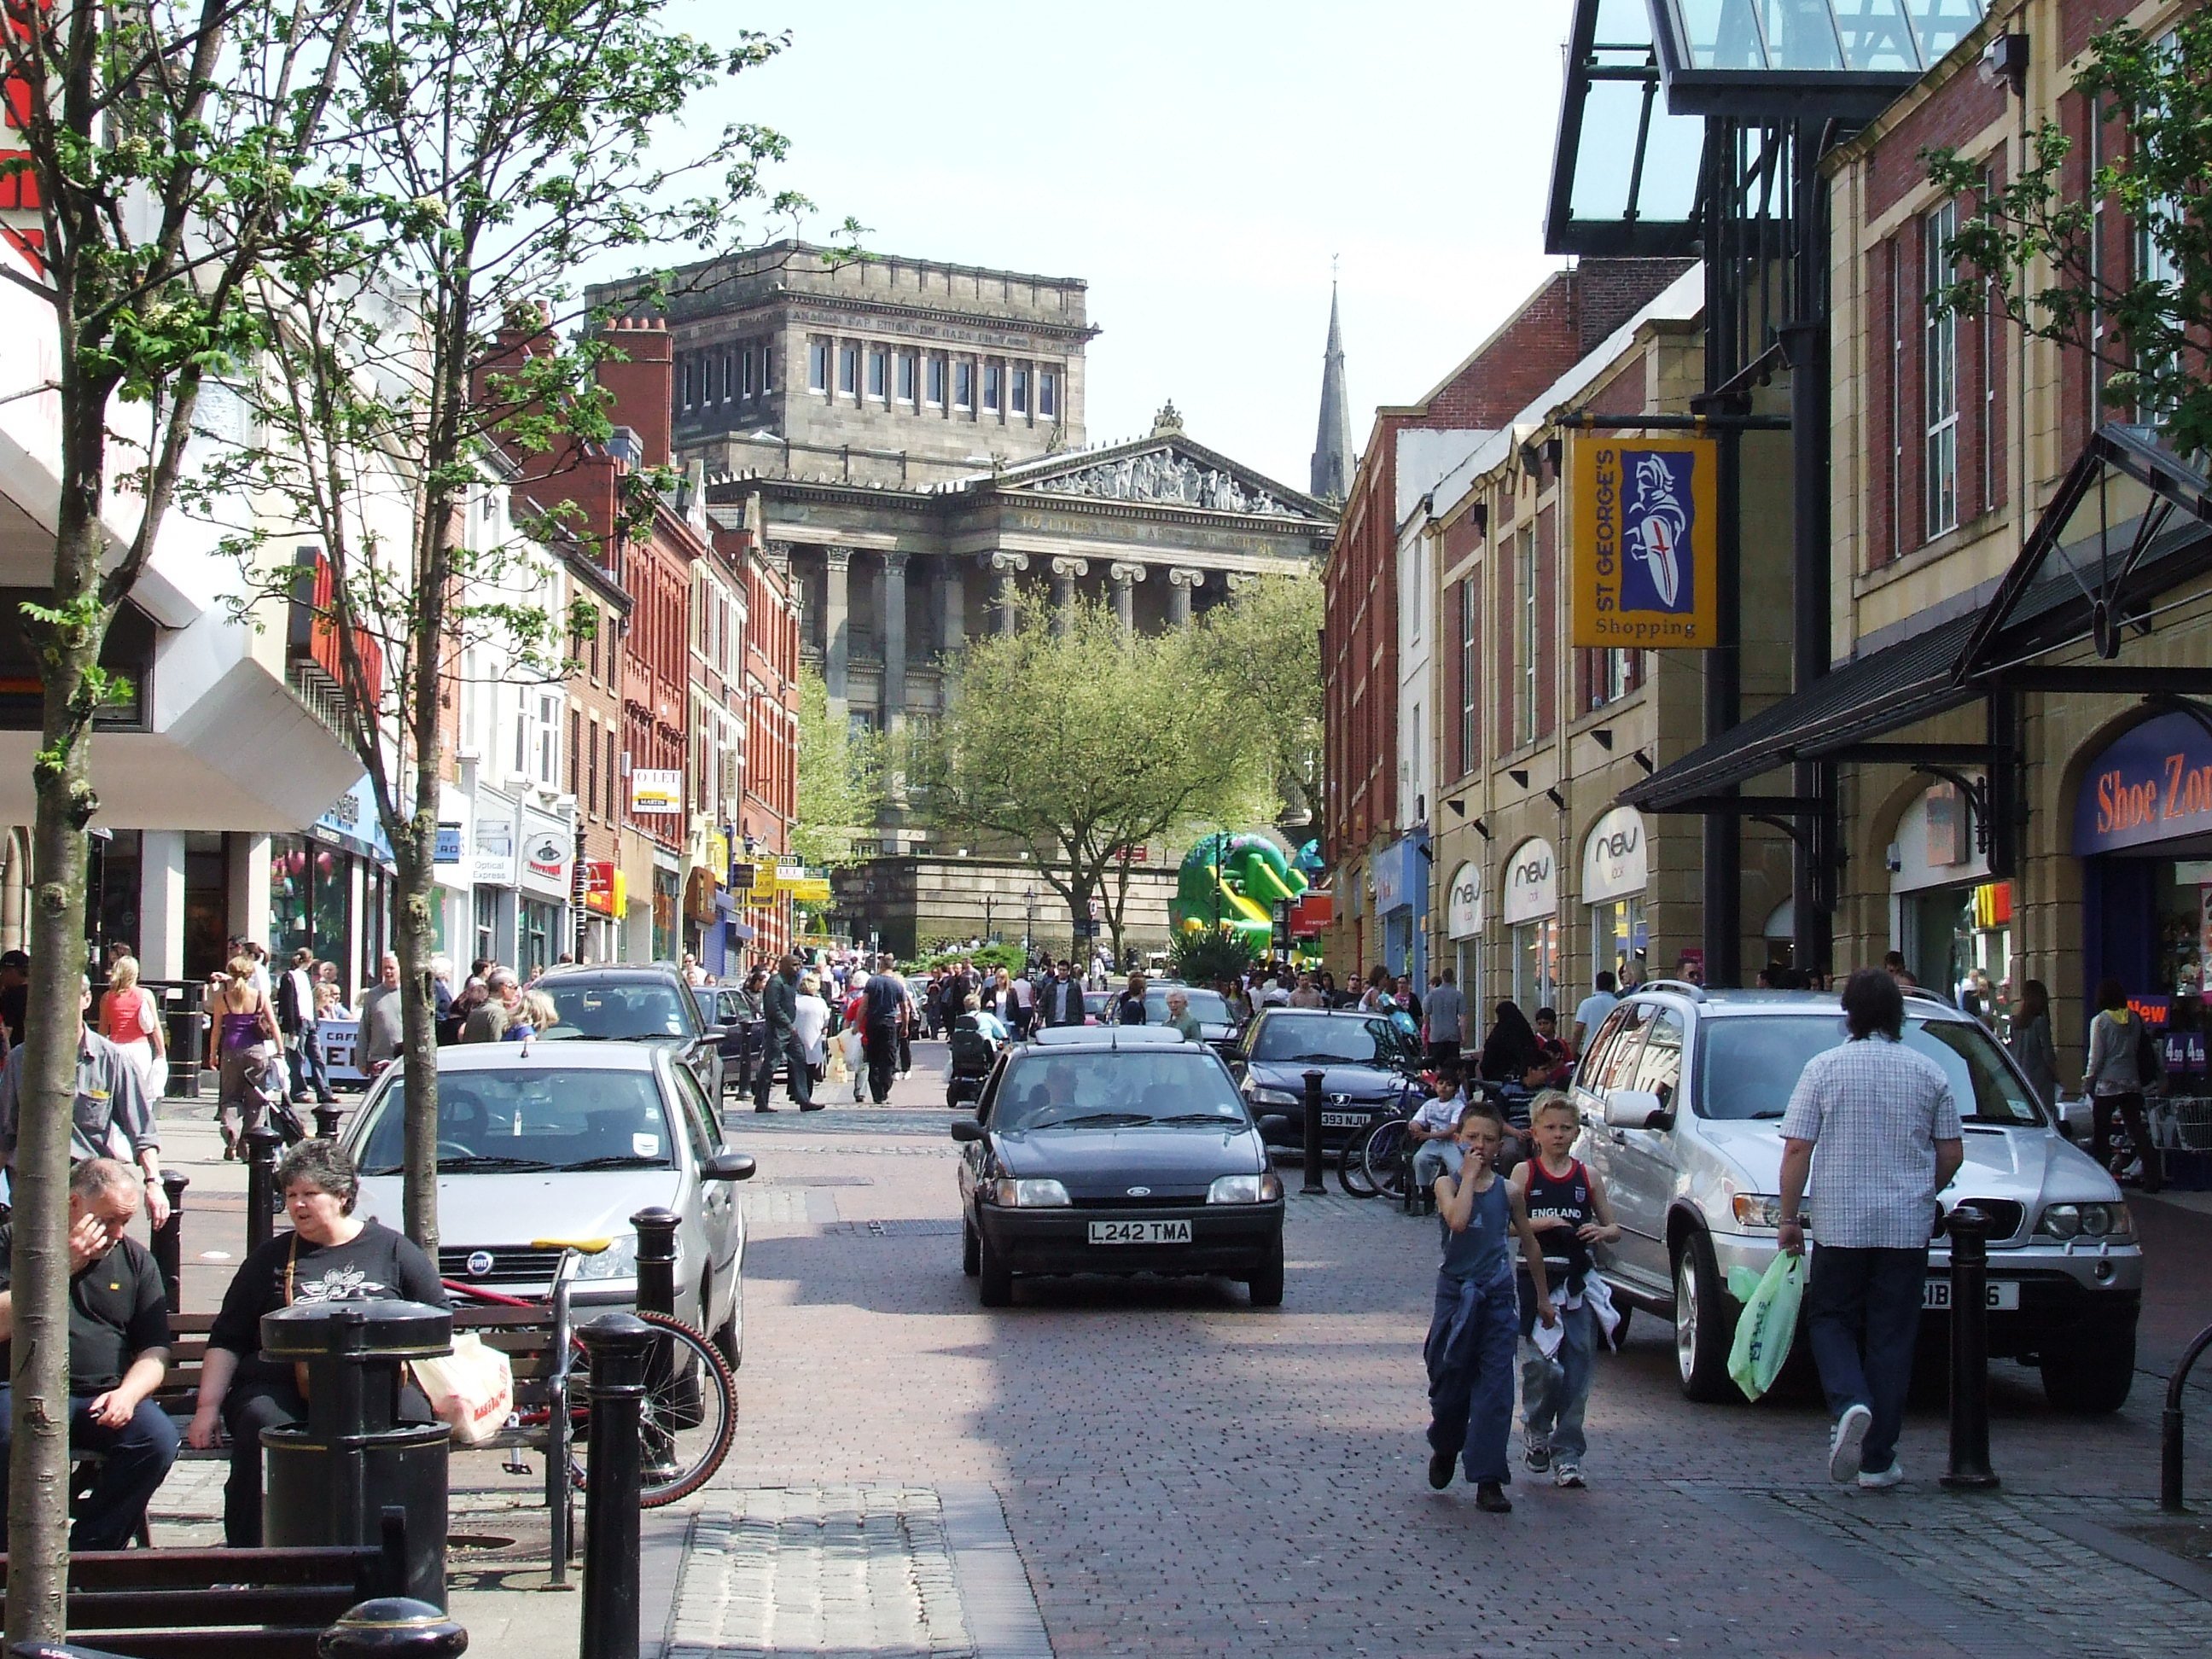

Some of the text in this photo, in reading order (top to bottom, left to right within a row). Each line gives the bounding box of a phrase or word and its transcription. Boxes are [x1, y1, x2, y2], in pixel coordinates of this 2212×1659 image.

[1596, 449, 1614, 612] ST GEORGE'S
[1596, 618, 1696, 638] Shopping
[653, 772, 678, 783] LET
[2097, 770, 2157, 834] Shoe
[474, 861, 504, 870] Optical
[473, 870, 506, 880] Express
[2127, 999, 2167, 1022] New
[327, 1032, 358, 1041] CAFF
[1531, 1208, 1582, 1220] ENGLAND
[1091, 1222, 1190, 1242] L242 TMA
